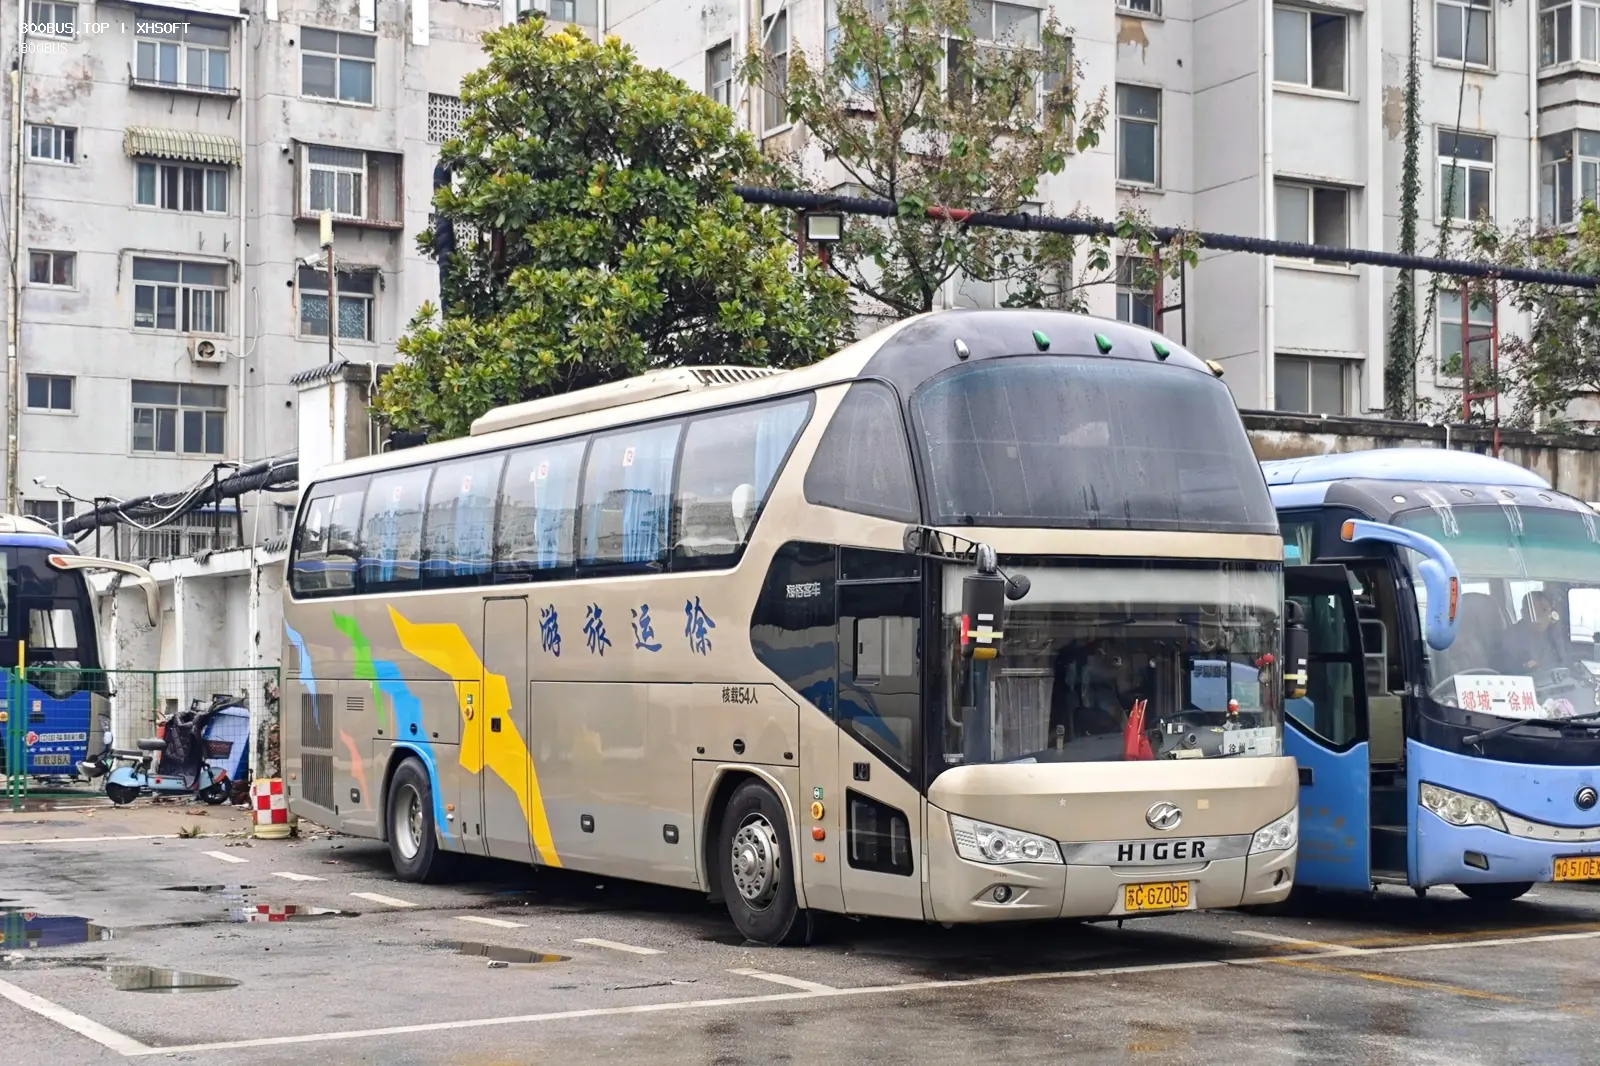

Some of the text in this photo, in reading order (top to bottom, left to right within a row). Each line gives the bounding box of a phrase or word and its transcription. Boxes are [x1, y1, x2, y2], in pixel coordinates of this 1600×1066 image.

[721, 686, 759, 705] 核载54人
[1117, 840, 1206, 862] HIGER
